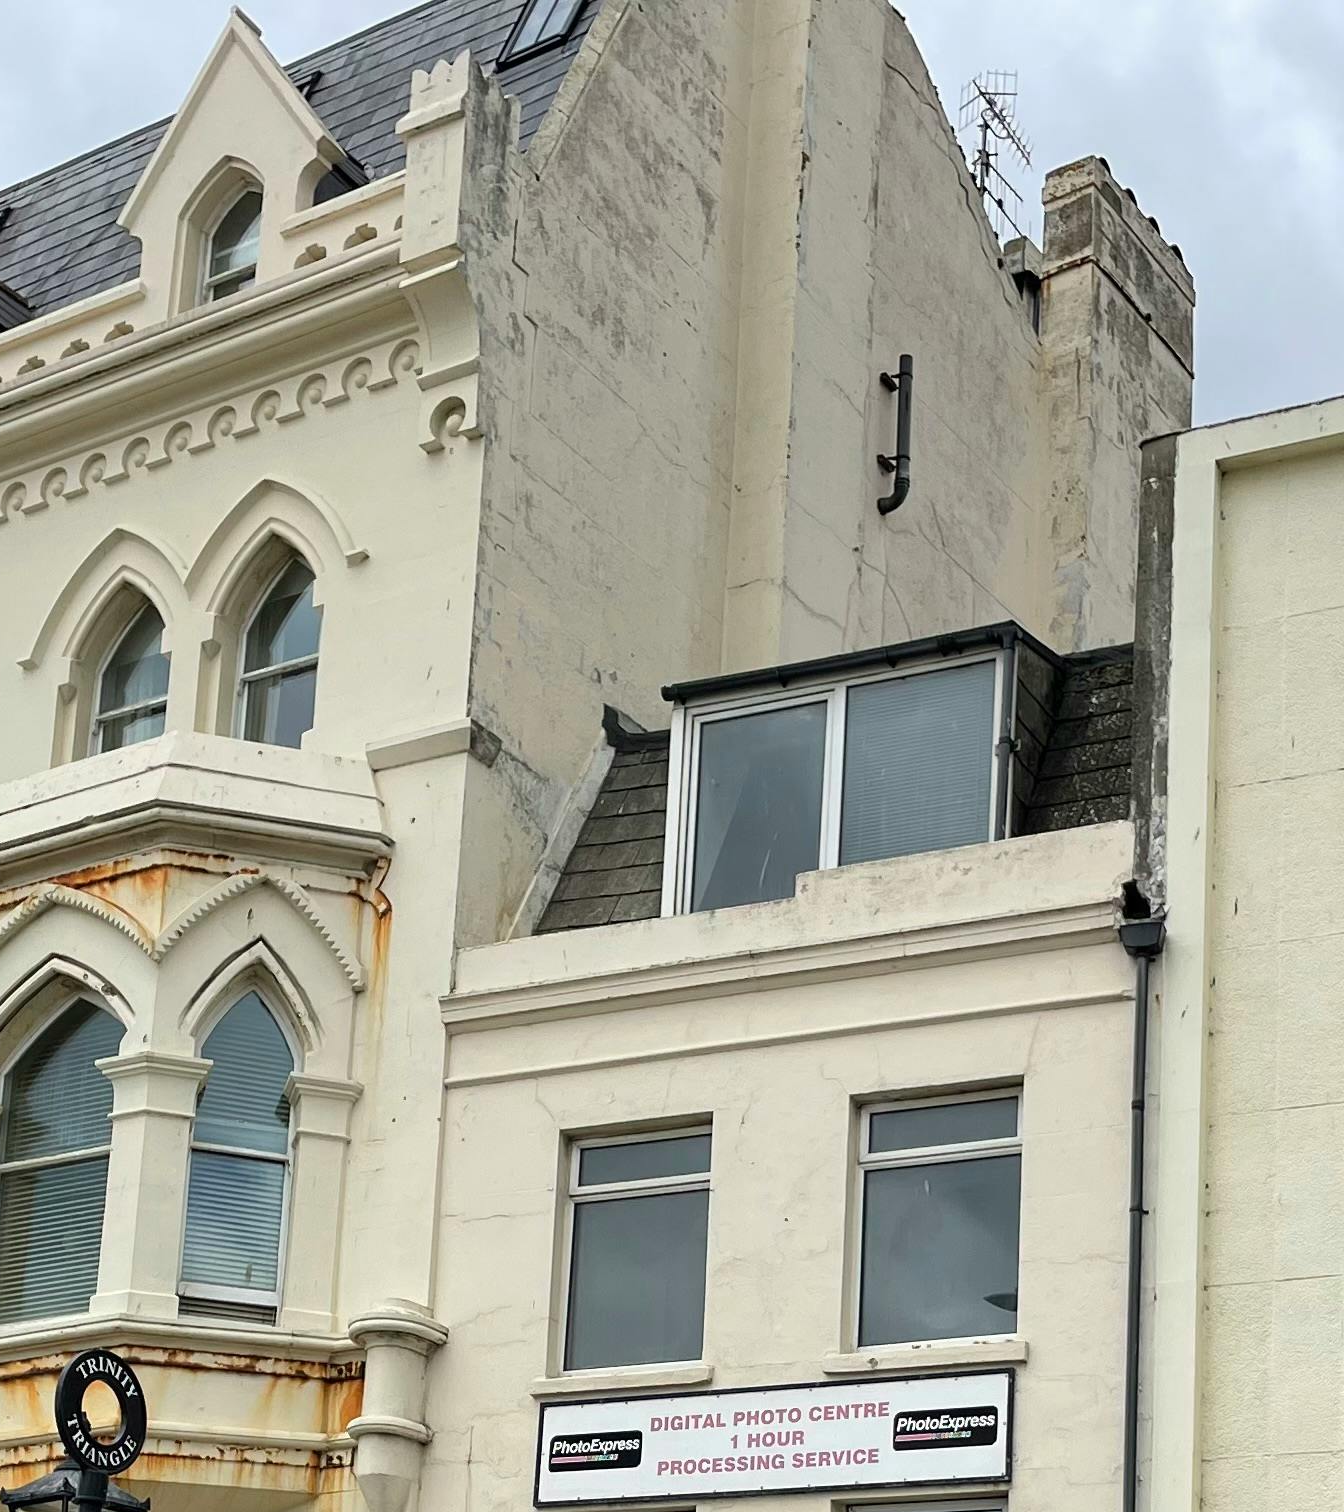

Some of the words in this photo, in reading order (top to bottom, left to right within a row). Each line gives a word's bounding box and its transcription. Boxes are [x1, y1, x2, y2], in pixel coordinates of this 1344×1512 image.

[76, 1356, 138, 1398] TRINITY
[650, 1413, 727, 1432] DIGITAL
[733, 1407, 802, 1426] PHOTO
[808, 1401, 890, 1421] CENTRE
[896, 1414, 995, 1433] PhotoExpress
[67, 1413, 137, 1467] TRIANGLE
[552, 1438, 640, 1455] PhotoExpress
[730, 1434, 738, 1449] 1
[747, 1430, 805, 1448] HOUR
[657, 1453, 785, 1476] PROCESSING
[791, 1448, 880, 1469] SERVICE
